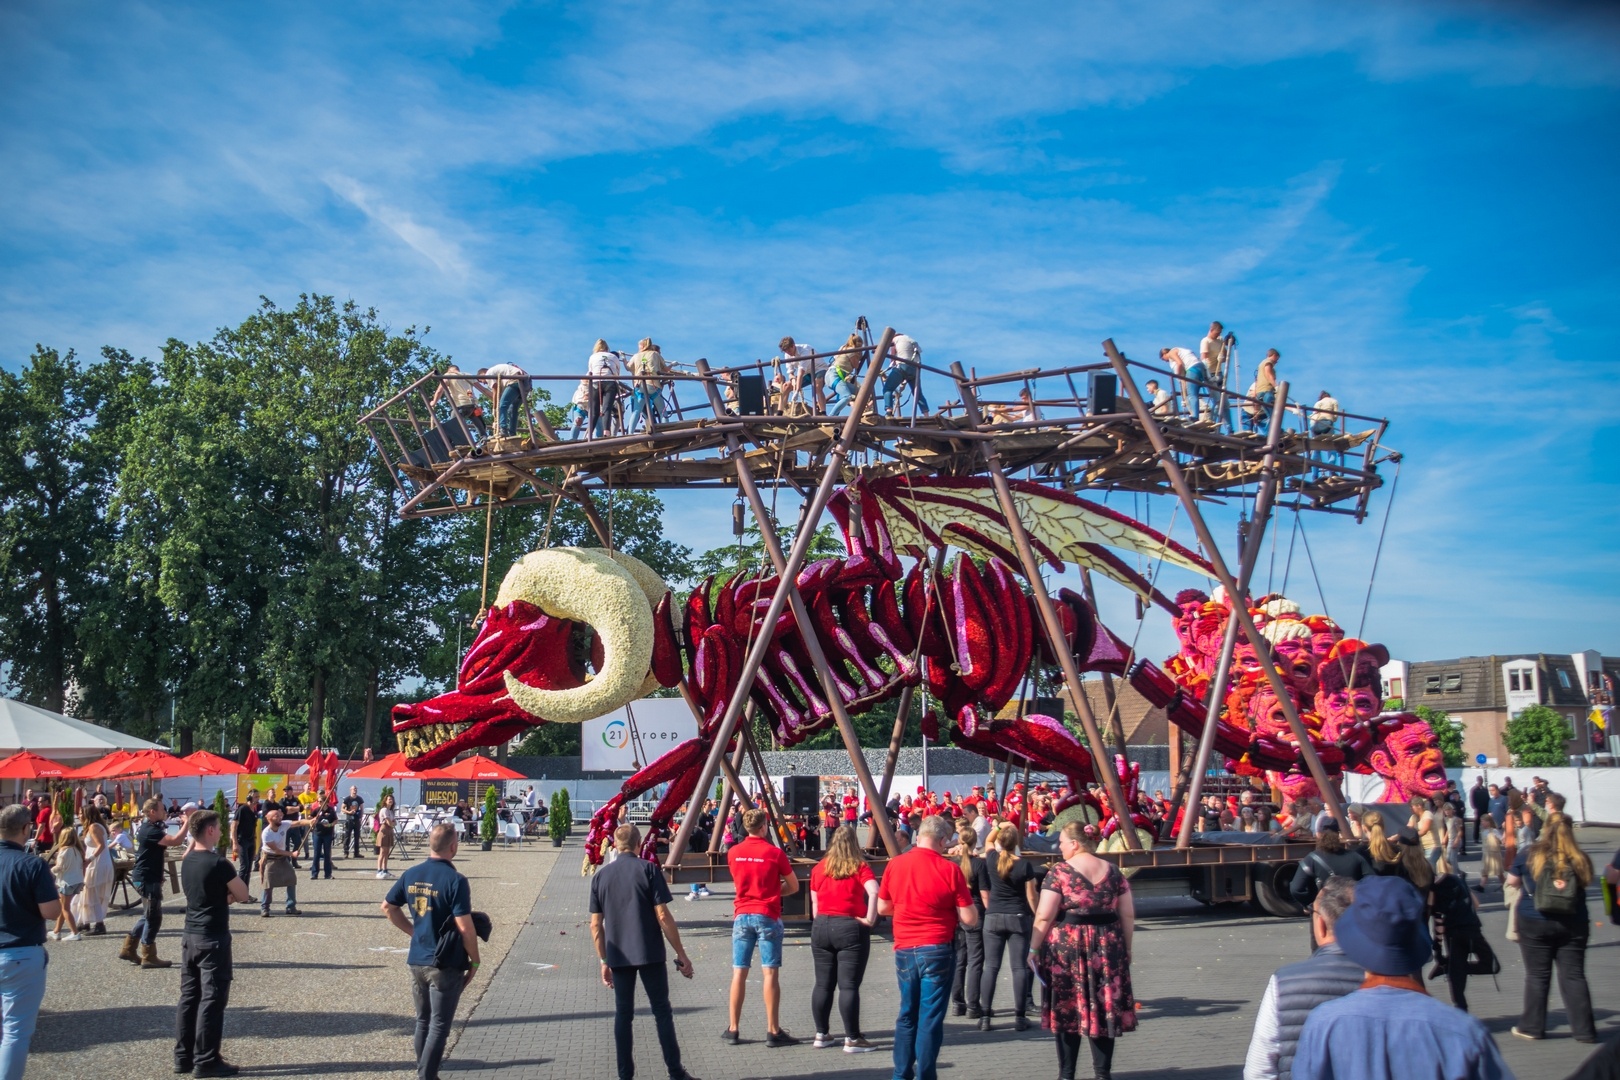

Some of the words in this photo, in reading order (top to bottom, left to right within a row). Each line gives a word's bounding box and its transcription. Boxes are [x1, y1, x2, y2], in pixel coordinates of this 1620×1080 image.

[609, 730, 622, 739] 21
[631, 730, 678, 741] Groep
[426, 791, 458, 805] UNESCO
